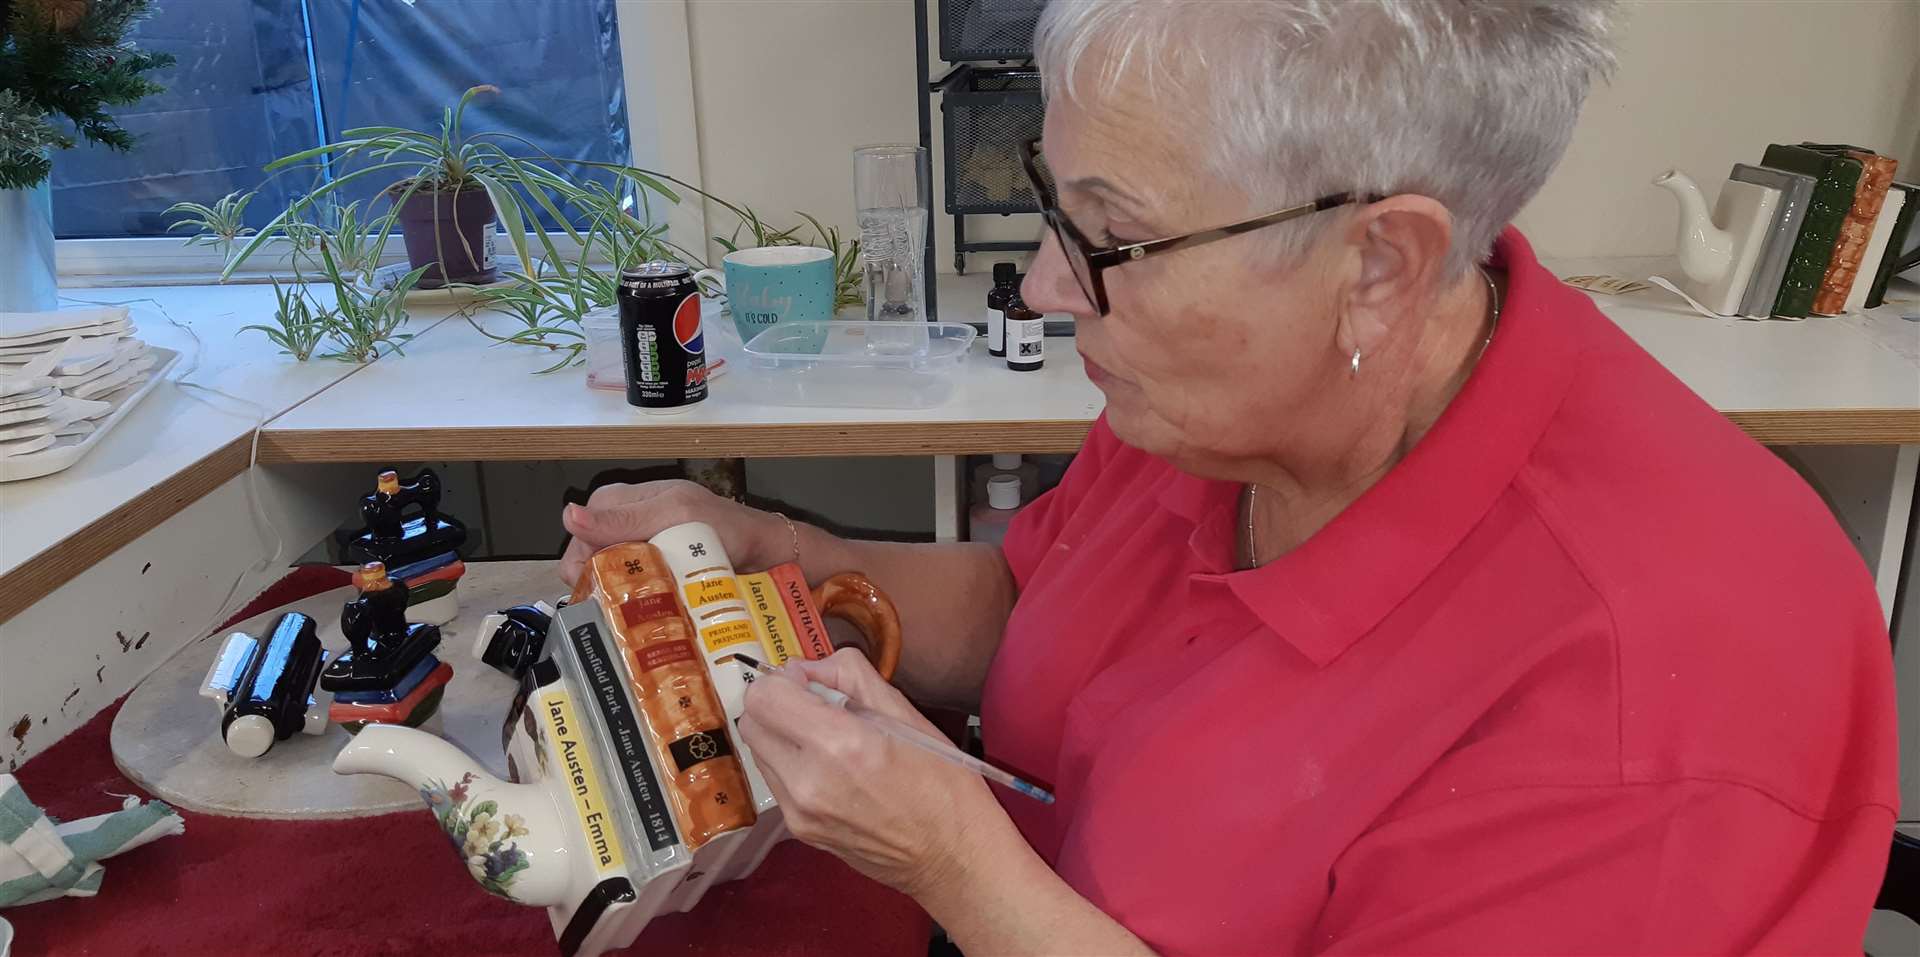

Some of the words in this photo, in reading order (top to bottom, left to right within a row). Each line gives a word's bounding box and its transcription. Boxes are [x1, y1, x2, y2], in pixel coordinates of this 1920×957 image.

[757, 312, 778, 325] COLD
[699, 592, 735, 605] Austen
[701, 579, 723, 591] Jane
[748, 580, 768, 611] Jane
[763, 614, 789, 662] Austen
[577, 626, 609, 684] Mansfield
[602, 685, 622, 715] Park
[618, 727, 635, 757] Jane
[629, 759, 652, 801] Austen
[650, 812, 671, 842] 1814
[548, 700, 568, 736] Jane
[561, 740, 588, 796] Austen
[586, 812, 612, 867] Emma
